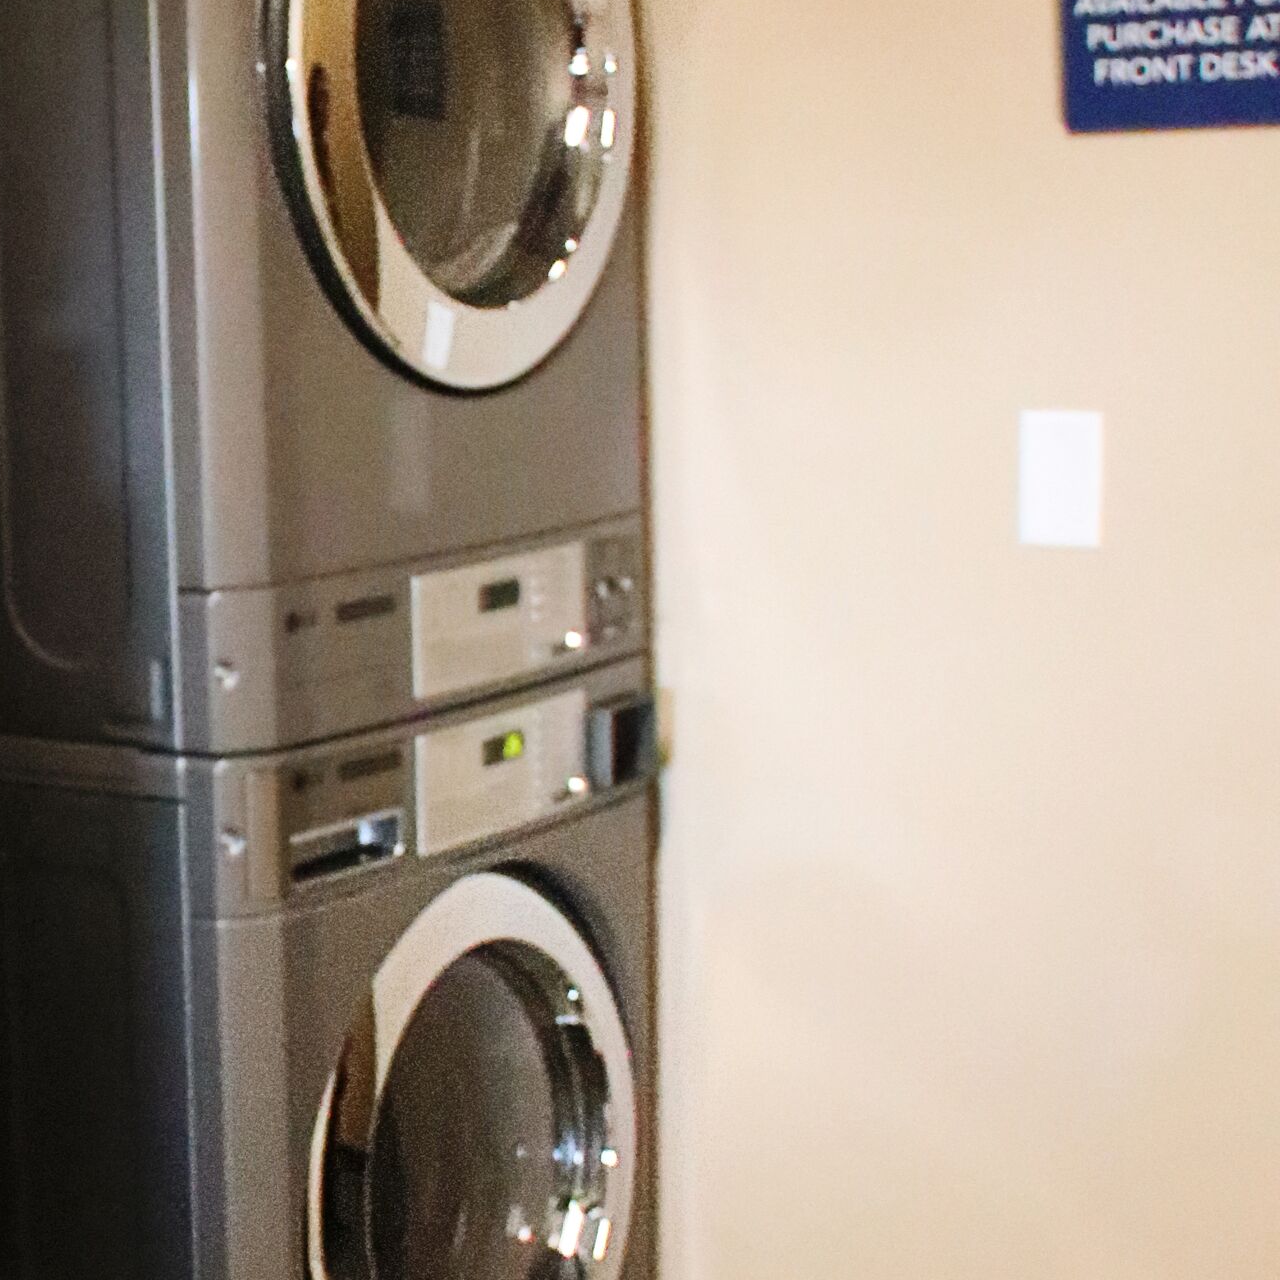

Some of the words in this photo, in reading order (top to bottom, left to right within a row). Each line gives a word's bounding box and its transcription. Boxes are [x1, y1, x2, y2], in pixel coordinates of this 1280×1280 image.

[1087, 16, 1239, 51] PURCHASE
[1094, 54, 1194, 85] FRONT
[1200, 51, 1279, 81] DESK
